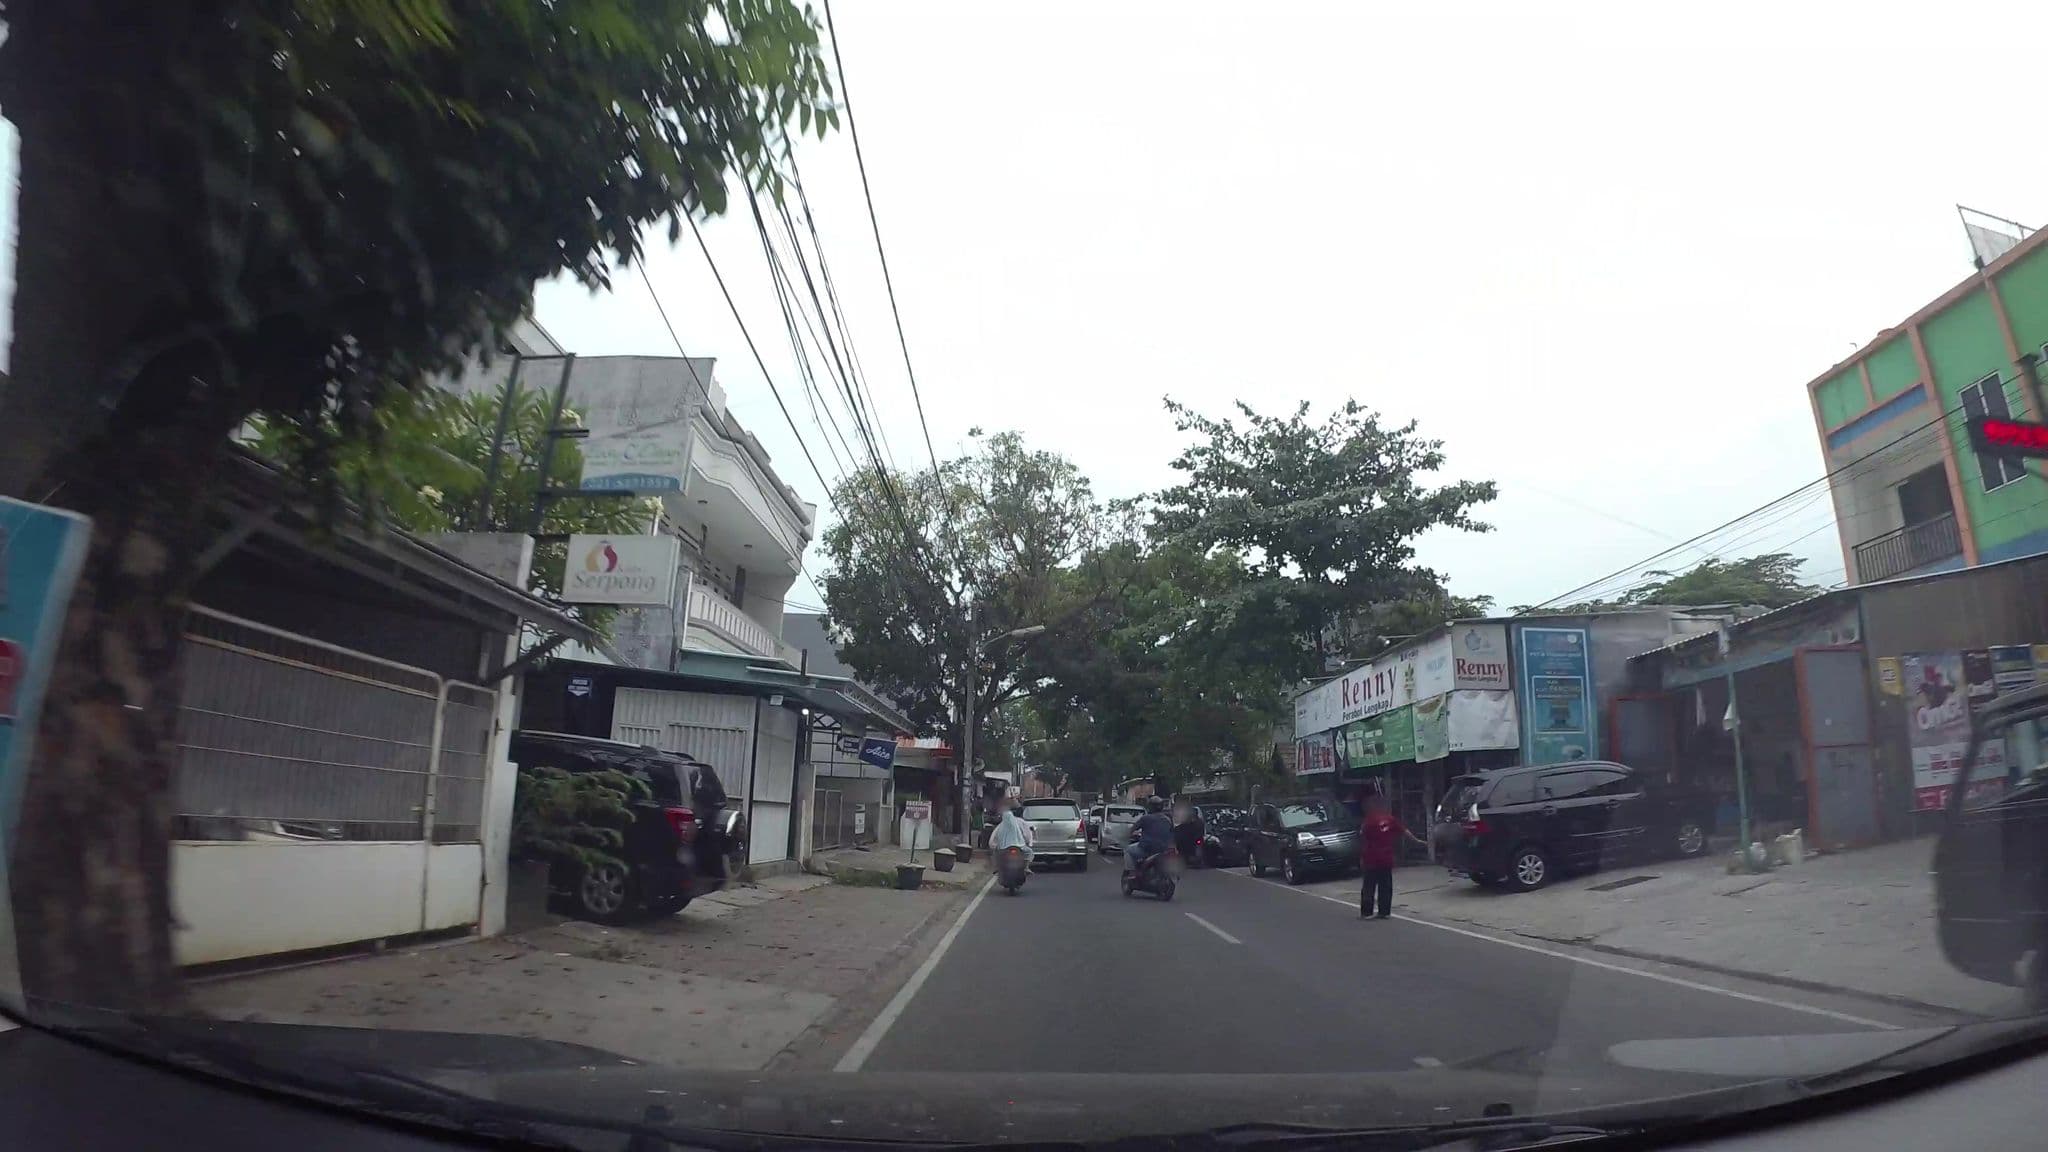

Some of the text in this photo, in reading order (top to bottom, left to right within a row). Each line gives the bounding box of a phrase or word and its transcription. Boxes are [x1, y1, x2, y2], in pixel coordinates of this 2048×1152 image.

[1456, 658, 1505, 682] Renny
[1342, 666, 1397, 709] Renny
[866, 746, 891, 760] Aice
